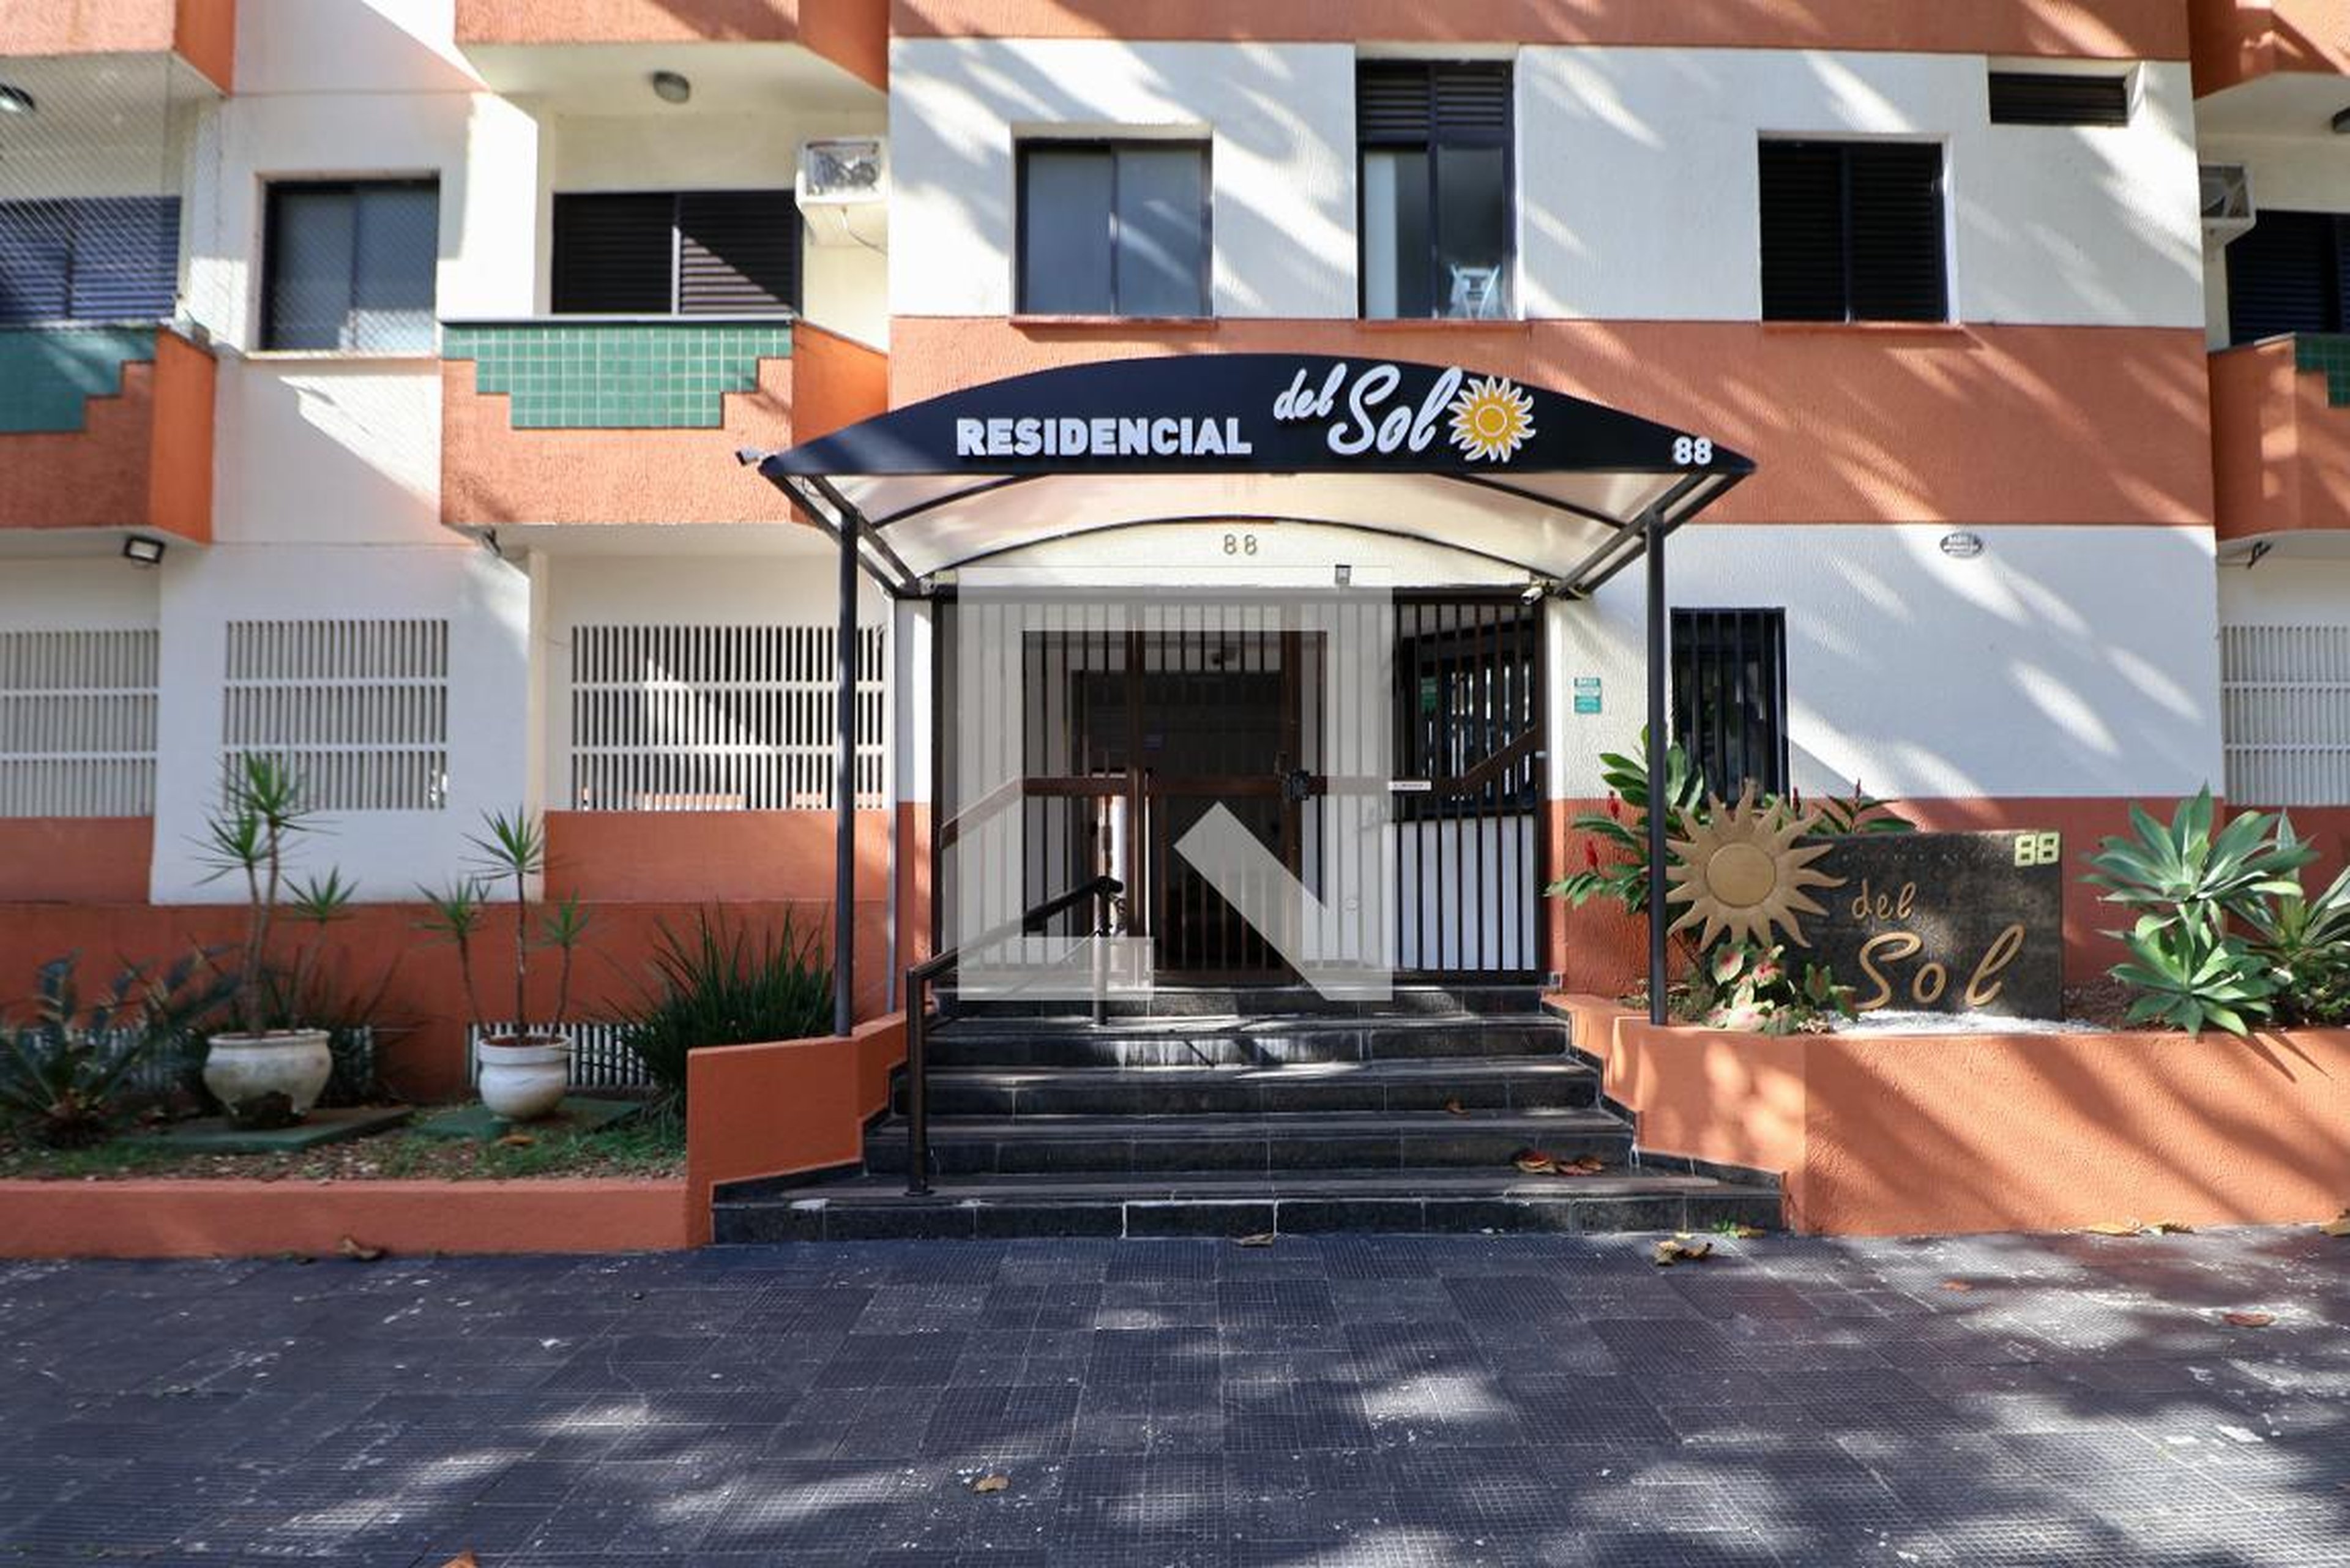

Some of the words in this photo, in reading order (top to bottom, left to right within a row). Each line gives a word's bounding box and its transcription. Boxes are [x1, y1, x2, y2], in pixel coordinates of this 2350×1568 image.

[957, 418, 1253, 456] RESIDENCIAL
[1273, 363, 1347, 420] del
[1327, 365, 1463, 455] Sol
[1673, 436, 1712, 465] 88
[1224, 534, 1258, 555] 88
[2015, 832, 2060, 867] 88
[1852, 878, 1917, 918] del
[1852, 925, 2025, 1009] Sol
